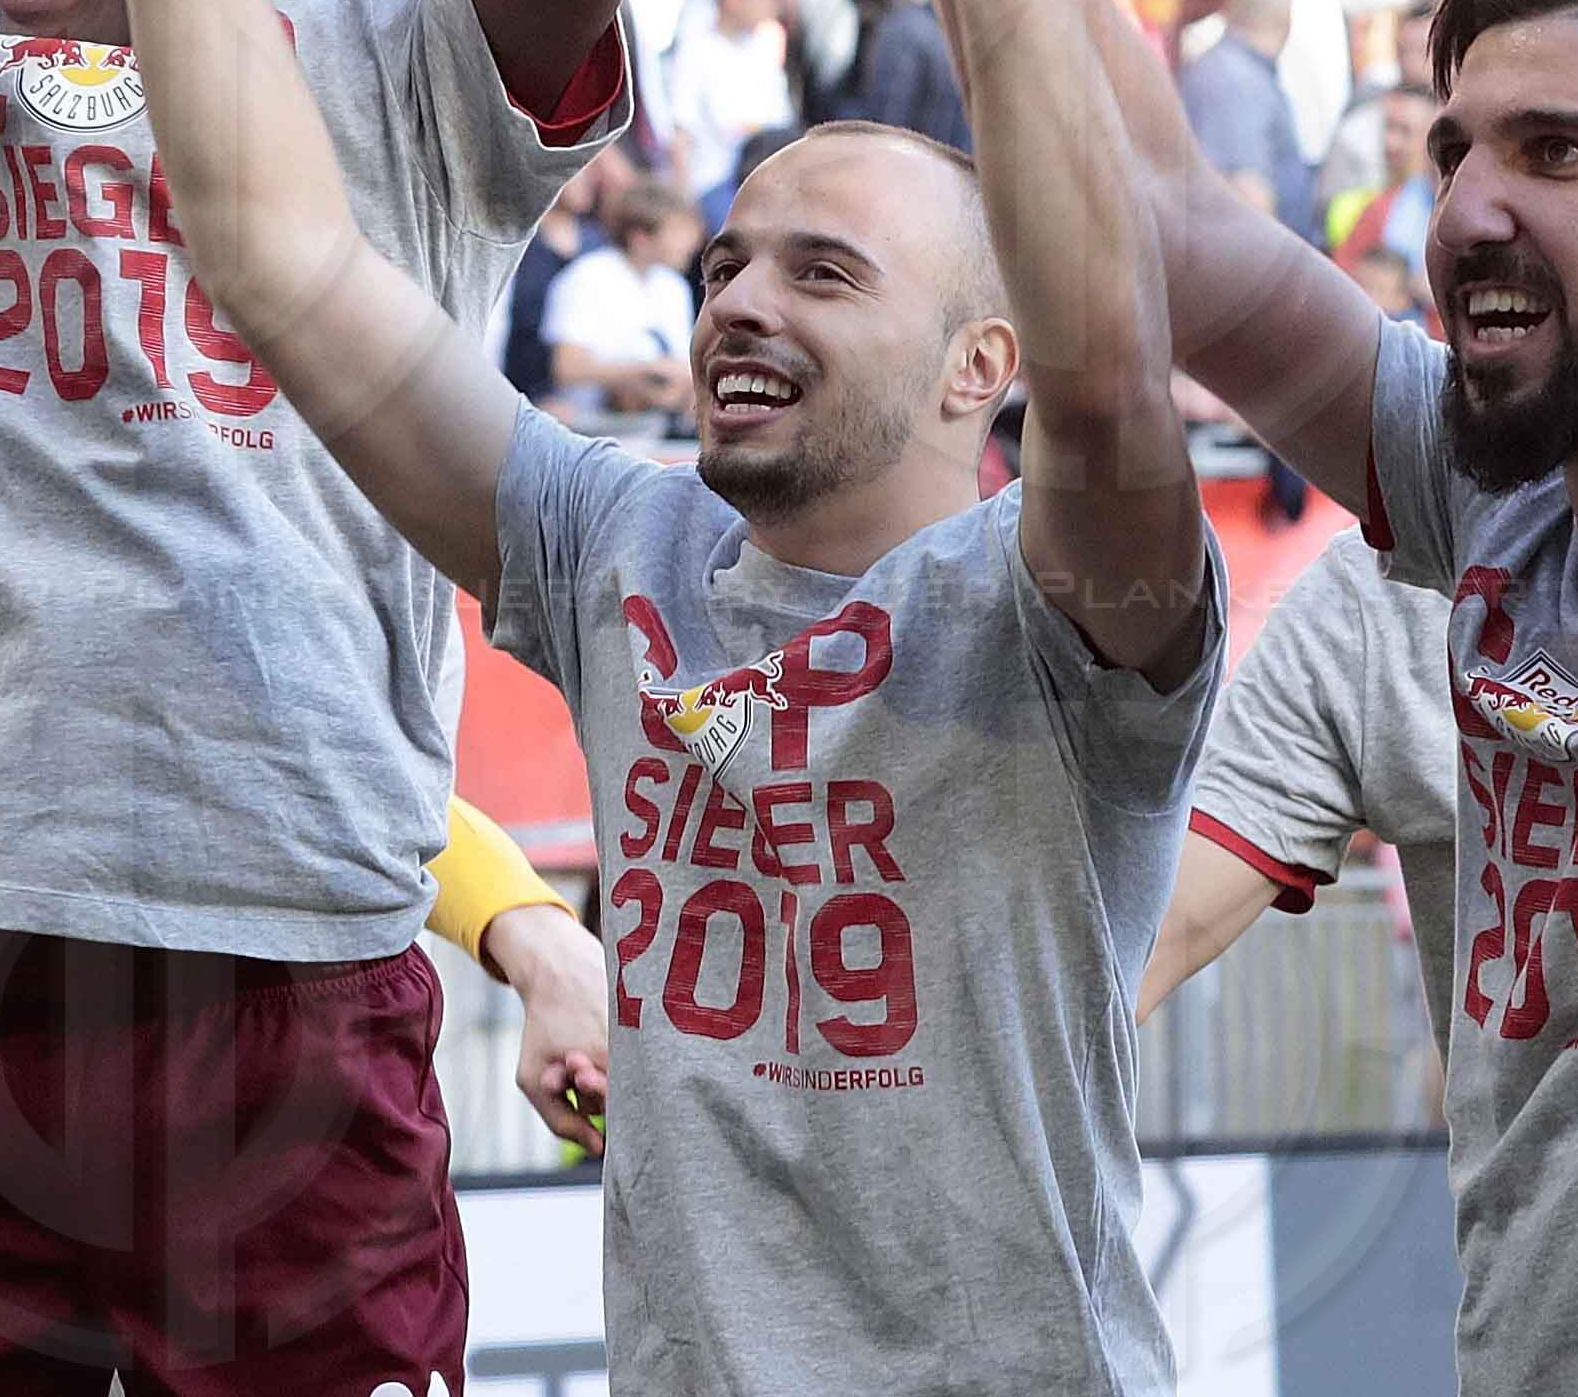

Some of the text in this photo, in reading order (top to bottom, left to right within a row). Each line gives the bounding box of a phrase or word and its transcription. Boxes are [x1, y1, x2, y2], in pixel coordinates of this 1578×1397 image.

[29, 74, 144, 121] SALZBURG
[611, 869, 919, 1058] 2019
[753, 1061, 924, 1091] #WIRSINDERFOLG
